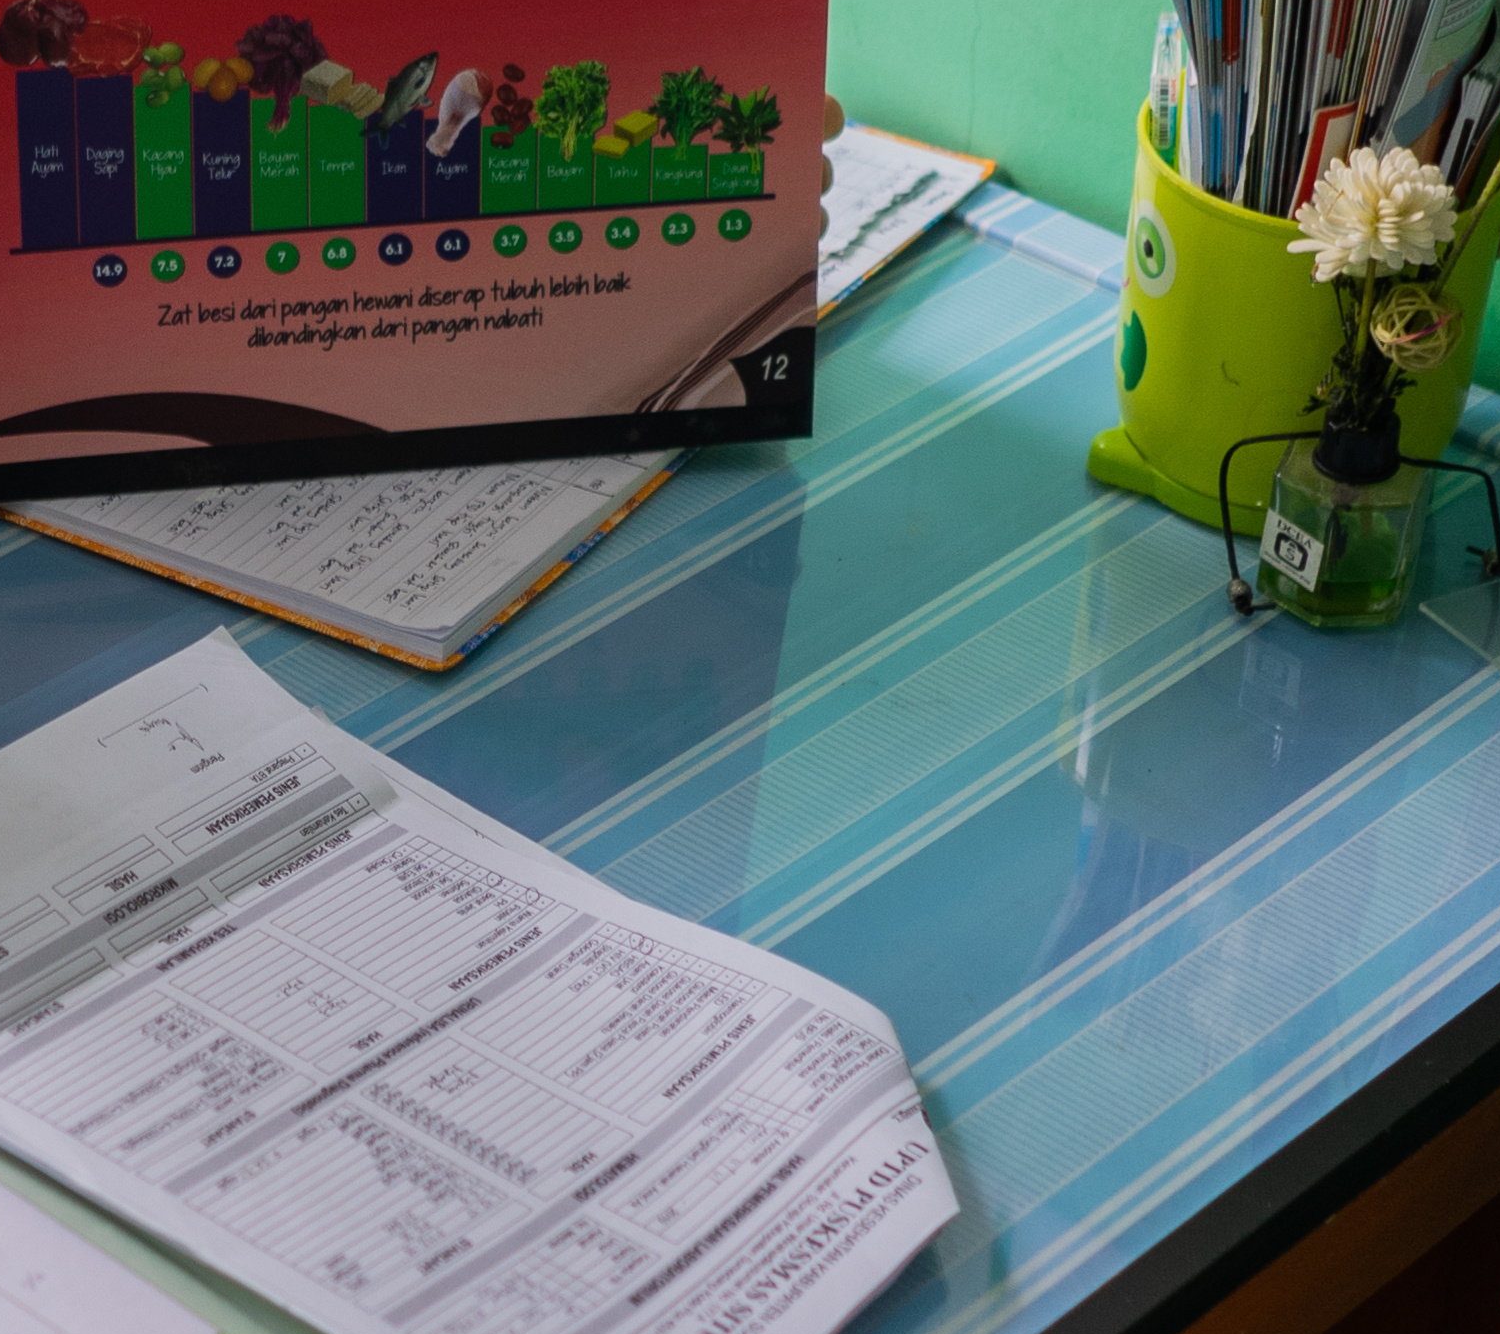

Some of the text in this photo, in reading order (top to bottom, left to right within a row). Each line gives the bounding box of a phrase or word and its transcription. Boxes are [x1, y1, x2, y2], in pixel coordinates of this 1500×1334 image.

[34, 143, 59, 159] Hati
[86, 145, 124, 165] Daging
[141, 146, 184, 165] Kacang
[202, 150, 240, 170] Kuning
[258, 149, 300, 167] Bayam
[30, 159, 64, 178] Ayam
[93, 160, 117, 179] Sapi
[208, 165, 235, 180] Telur
[259, 164, 299, 179] Merah
[319, 157, 354, 176] Tempe
[382, 160, 406, 175] Ikan
[436, 160, 467, 180] Ayam
[488, 154, 529, 173] Kacang
[546, 164, 584, 182] Bayam
[609, 165, 637, 179] Tahu
[490, 169, 526, 185] Merah
[611, 227, 631, 240] 3.4
[668, 222, 687, 236] 2.3
[725, 219, 742, 231] 1.3
[444, 239, 460, 252] 6.1
[501, 235, 519, 248] 3.7
[555, 231, 574, 244] 3.5
[278, 252, 285, 265] 7
[327, 248, 346, 261] 6.8
[385, 243, 401, 256] 6.1
[96, 264, 122, 278] 14.9
[157, 260, 177, 273] 7.5
[215, 256, 233, 269] 7.2
[157, 270, 631, 327] Zat besi dari pangan hewani diserap tubuh lebih baik
[246, 304, 542, 356] dibandingkan dari pangan nabati
[761, 354, 788, 380] 12
[185, 750, 227, 776] Pengirim
[247, 769, 270, 784] BTA
[201, 774, 306, 838] JENIS PEMERIKSAAN
[296, 805, 350, 838] Tes Kehamilan
[256, 828, 357, 891] JENIS PEMERIKSAAN
[101, 868, 142, 894] HASIL
[98, 874, 182, 927] MIKROBIOLOGI
[156, 923, 195, 949] HASIL
[446, 925, 545, 992] JENIS PEMERIKSAAN
[427, 995, 482, 1033] URINALISA
[347, 1028, 385, 1054] HASIL
[652, 1013, 763, 1100] JENIS PEMERIKSAAN
[765, 1153, 810, 1186] HASIL
[862, 1138, 931, 1190] UPTD
[569, 1150, 643, 1203] HEMATOLOGI
[878, 1172, 926, 1208] DINAS
[697, 1180, 784, 1245] PEMERIKSAAN
[814, 1202, 895, 1264] KESEHATAN
[742, 1185, 877, 1306] PUSKESMAS
[751, 1261, 834, 1324] KABUPATEN
